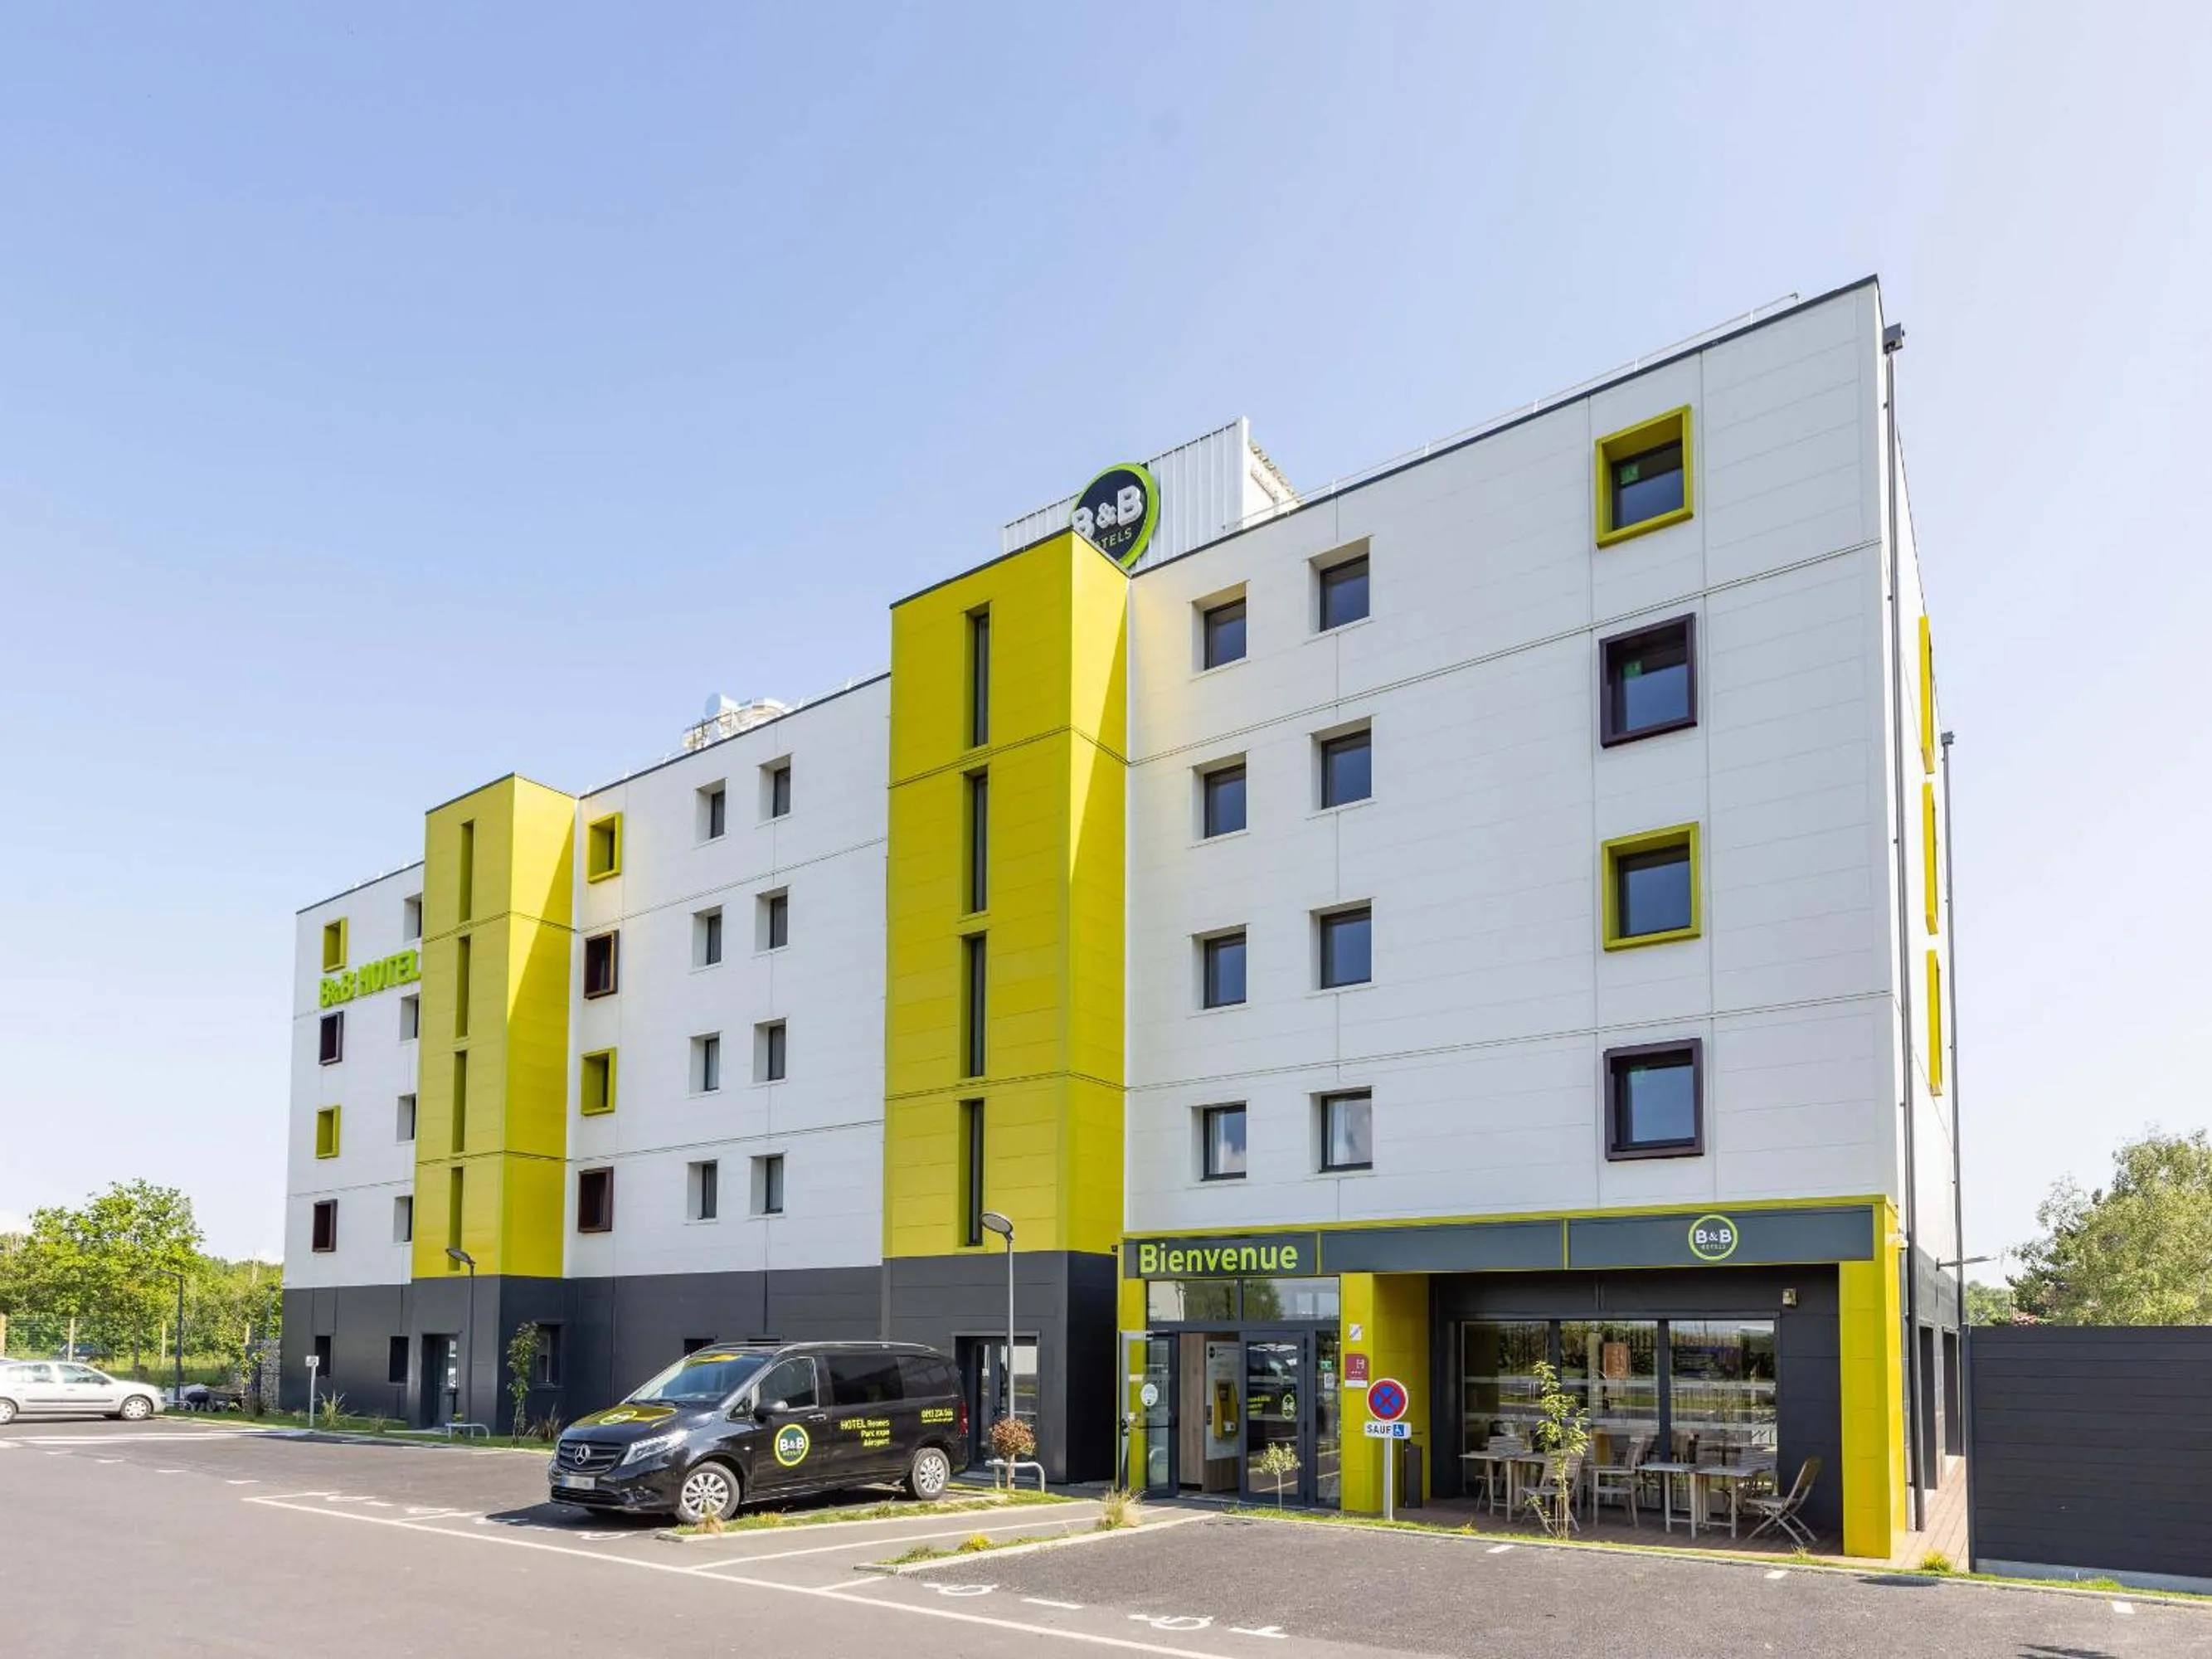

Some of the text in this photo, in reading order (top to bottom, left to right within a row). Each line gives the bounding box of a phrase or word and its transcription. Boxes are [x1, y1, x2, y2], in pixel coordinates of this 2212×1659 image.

[1072, 485, 1144, 540] B&B
[1096, 528, 1132, 549] TELS
[320, 948, 421, 1008] B&B HOTEL
[1695, 1228, 1732, 1243] B&B
[1140, 1243, 1298, 1273] Bienvenue
[840, 1418, 866, 1430] HOTEL
[1367, 1423, 1391, 1433] SAUF
[780, 1437, 805, 1452] B&B
